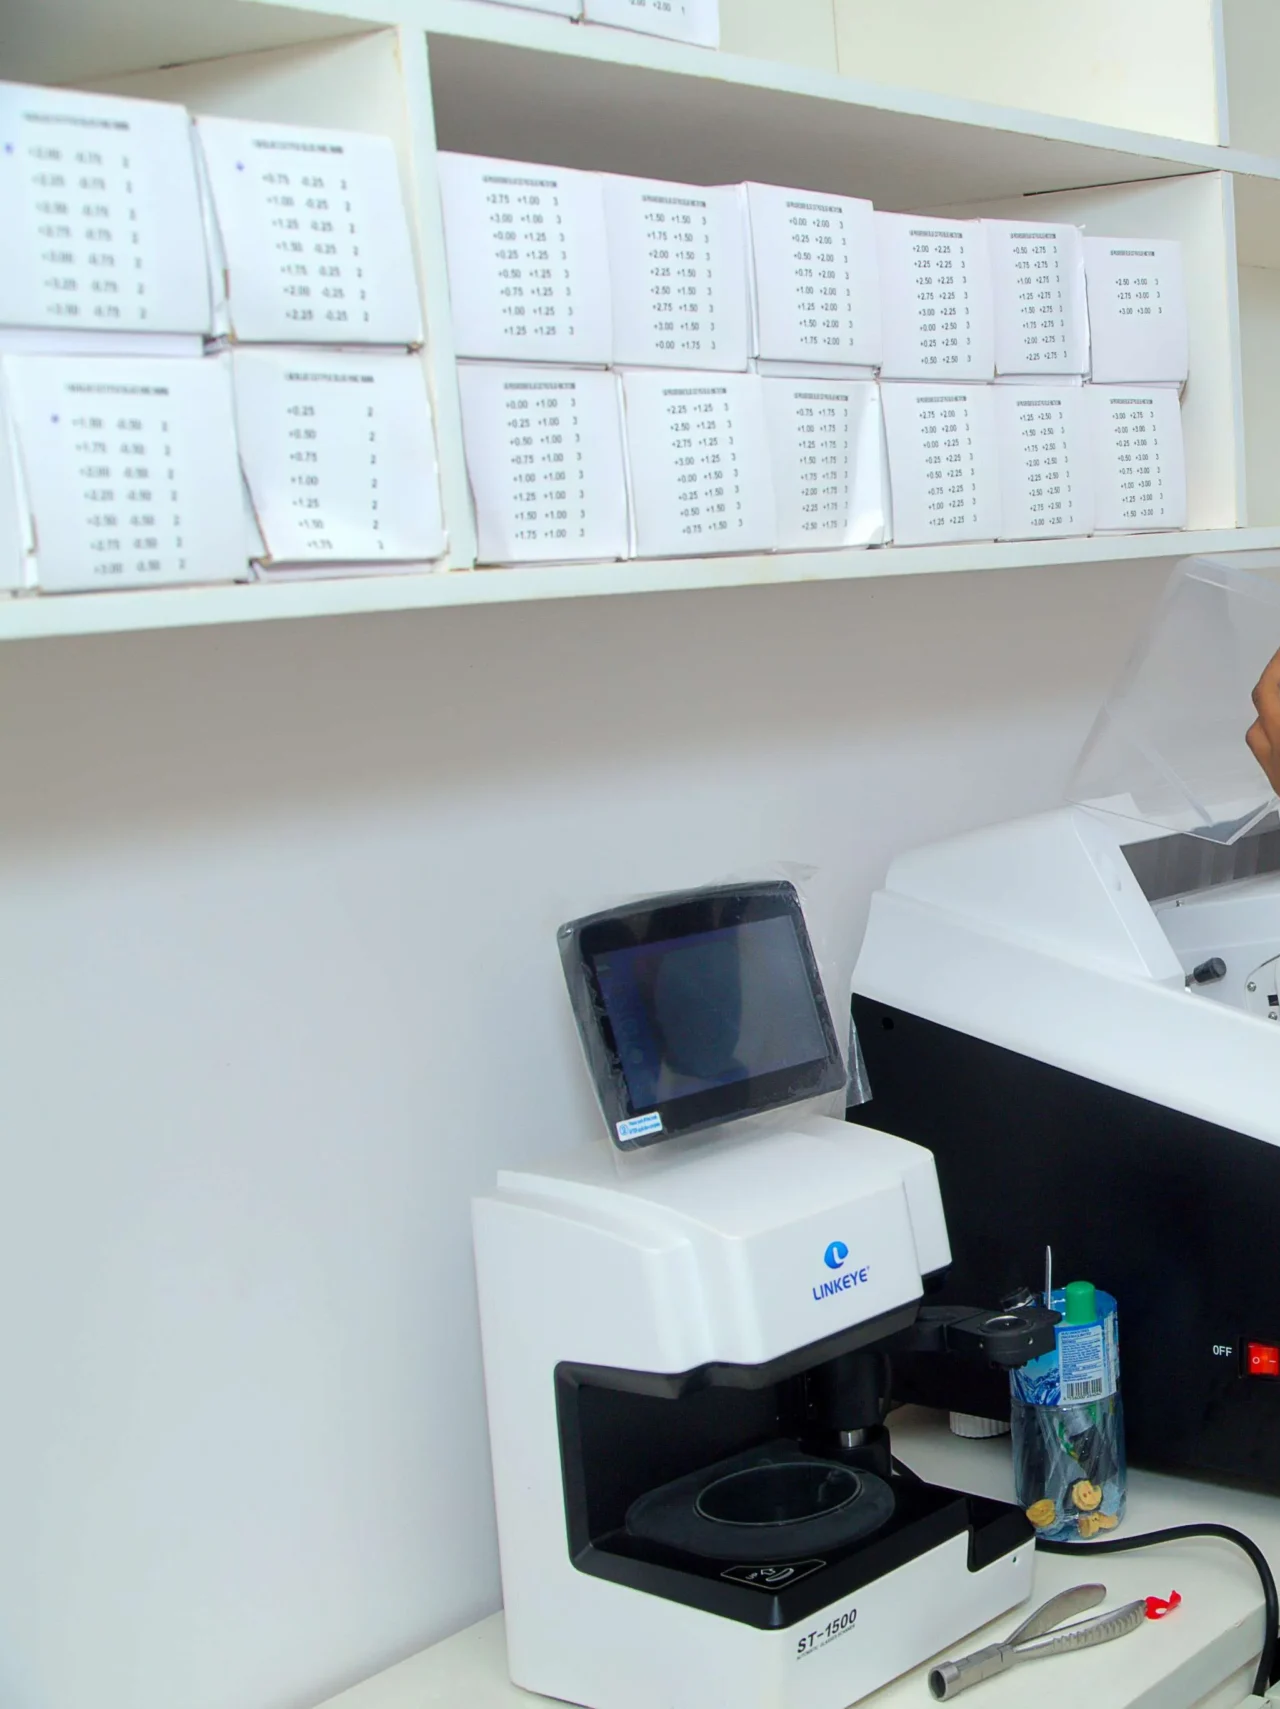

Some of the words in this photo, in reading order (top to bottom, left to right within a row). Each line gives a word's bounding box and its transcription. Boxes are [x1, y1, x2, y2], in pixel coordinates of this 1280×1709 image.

[792, 234, 810, 243] +0.25
[815, 235, 833, 245] +2.00
[649, 249, 669, 259] +2.00
[675, 251, 695, 260] +1.50
[912, 245, 929, 253] +2.00
[934, 245, 951, 254] +2.25
[793, 251, 812, 261] +0.50
[816, 253, 834, 263] +2.00
[914, 260, 931, 268] +2.25
[936, 260, 952, 269] +2.25
[650, 267, 671, 277] +2.25
[677, 268, 696, 278] +1.50
[795, 268, 813, 278] +0.75
[818, 270, 836, 279] +2.00
[1115, 278, 1130, 286] +2.50
[1133, 278, 1148, 286] +3.00
[917, 292, 934, 301] +2.75
[938, 291, 955, 300] +2.25
[1117, 292, 1132, 300] +2.75
[1135, 292, 1149, 300] +3.00
[652, 302, 673, 312] +2.75
[679, 303, 698, 312] +1.50
[918, 308, 936, 316] +3.00
[940, 307, 956, 316] +2.25
[1119, 307, 1133, 315] +3.00
[655, 340, 675, 350] +0.00
[681, 340, 701, 350] +1.75
[800, 336, 818, 344] +1.75
[823, 337, 840, 345] +2.00
[506, 400, 529, 409] +0.00
[536, 398, 558, 408] +1.00
[667, 405, 687, 415] +2.25
[693, 403, 713, 413] +1.25
[919, 410, 935, 419] +2.75
[940, 410, 956, 419] +2.00
[1020, 413, 1034, 422] +1.25
[1038, 412, 1052, 420] +2.50
[1112, 412, 1126, 420] +3.00
[1130, 411, 1144, 419] +2.75
[507, 418, 530, 429] +0.25
[538, 417, 560, 426] +1.00
[670, 422, 691, 432] +2.50
[696, 420, 716, 430] +1.25
[1022, 429, 1036, 437] +1.50
[1040, 427, 1054, 436] +2.50
[1114, 426, 1129, 434] +0.00
[1132, 425, 1146, 433] +3.00
[923, 440, 939, 449] +0.00
[943, 438, 959, 448] +2.25
[1116, 439, 1130, 447] +0.25
[511, 454, 534, 465] +0.75
[541, 453, 564, 462] +1.00
[674, 456, 695, 466] +3.00
[700, 454, 721, 464] +1.25
[925, 455, 941, 464] +0.25
[945, 453, 961, 463] +2.25
[1026, 459, 1040, 467] +2.00
[1043, 457, 1058, 465] +2.50
[1117, 454, 1132, 462] +0.50
[1135, 453, 1149, 461] +3.00
[677, 473, 697, 483] +0.00
[703, 470, 723, 480] +1.50
[926, 470, 942, 479] +0.50
[947, 468, 963, 478] +2.25
[1028, 473, 1042, 482] +2.25
[1045, 472, 1059, 480] +2.50
[515, 511, 537, 520] +1.50
[544, 510, 567, 519] +1.00
[812, 1268, 868, 1301] LINKEYE
[1212, 1345, 1232, 1357] OFF
[797, 1608, 858, 1654] ST-1500
